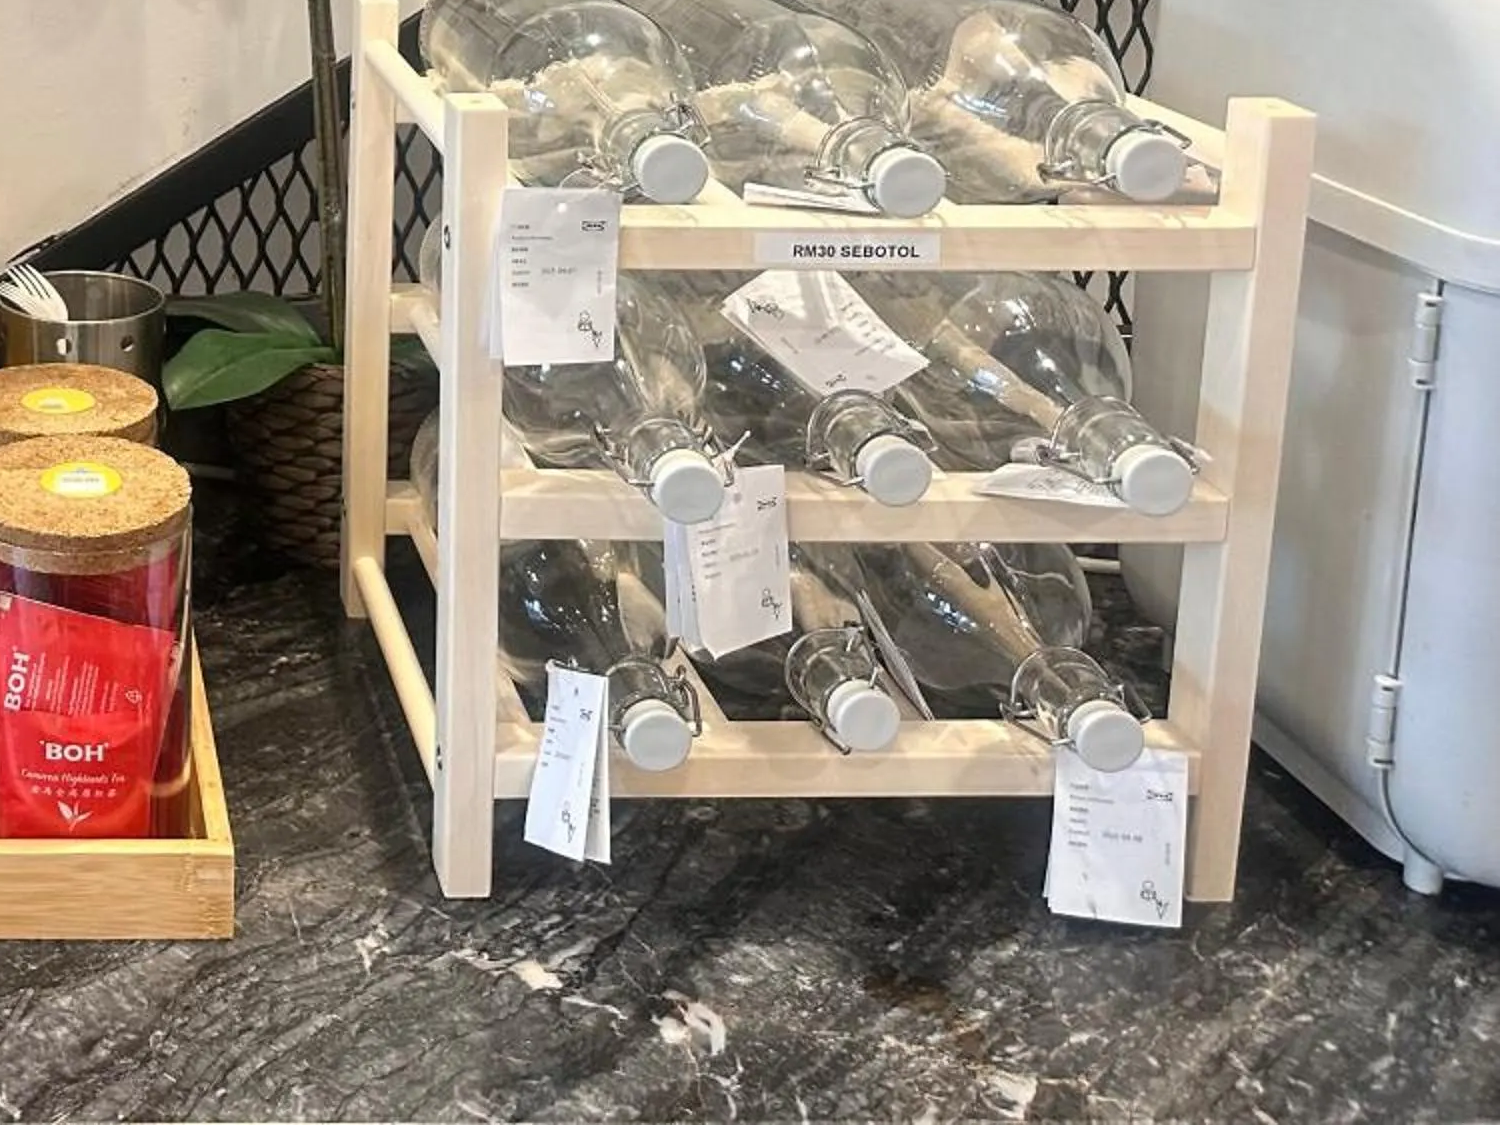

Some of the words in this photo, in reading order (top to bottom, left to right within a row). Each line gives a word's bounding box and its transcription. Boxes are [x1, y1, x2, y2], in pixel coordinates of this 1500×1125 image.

[793, 244, 836, 258] RM30
[840, 244, 920, 258] SEBOTOL
[3, 651, 31, 711] BOH
[45, 742, 104, 763] BOH
